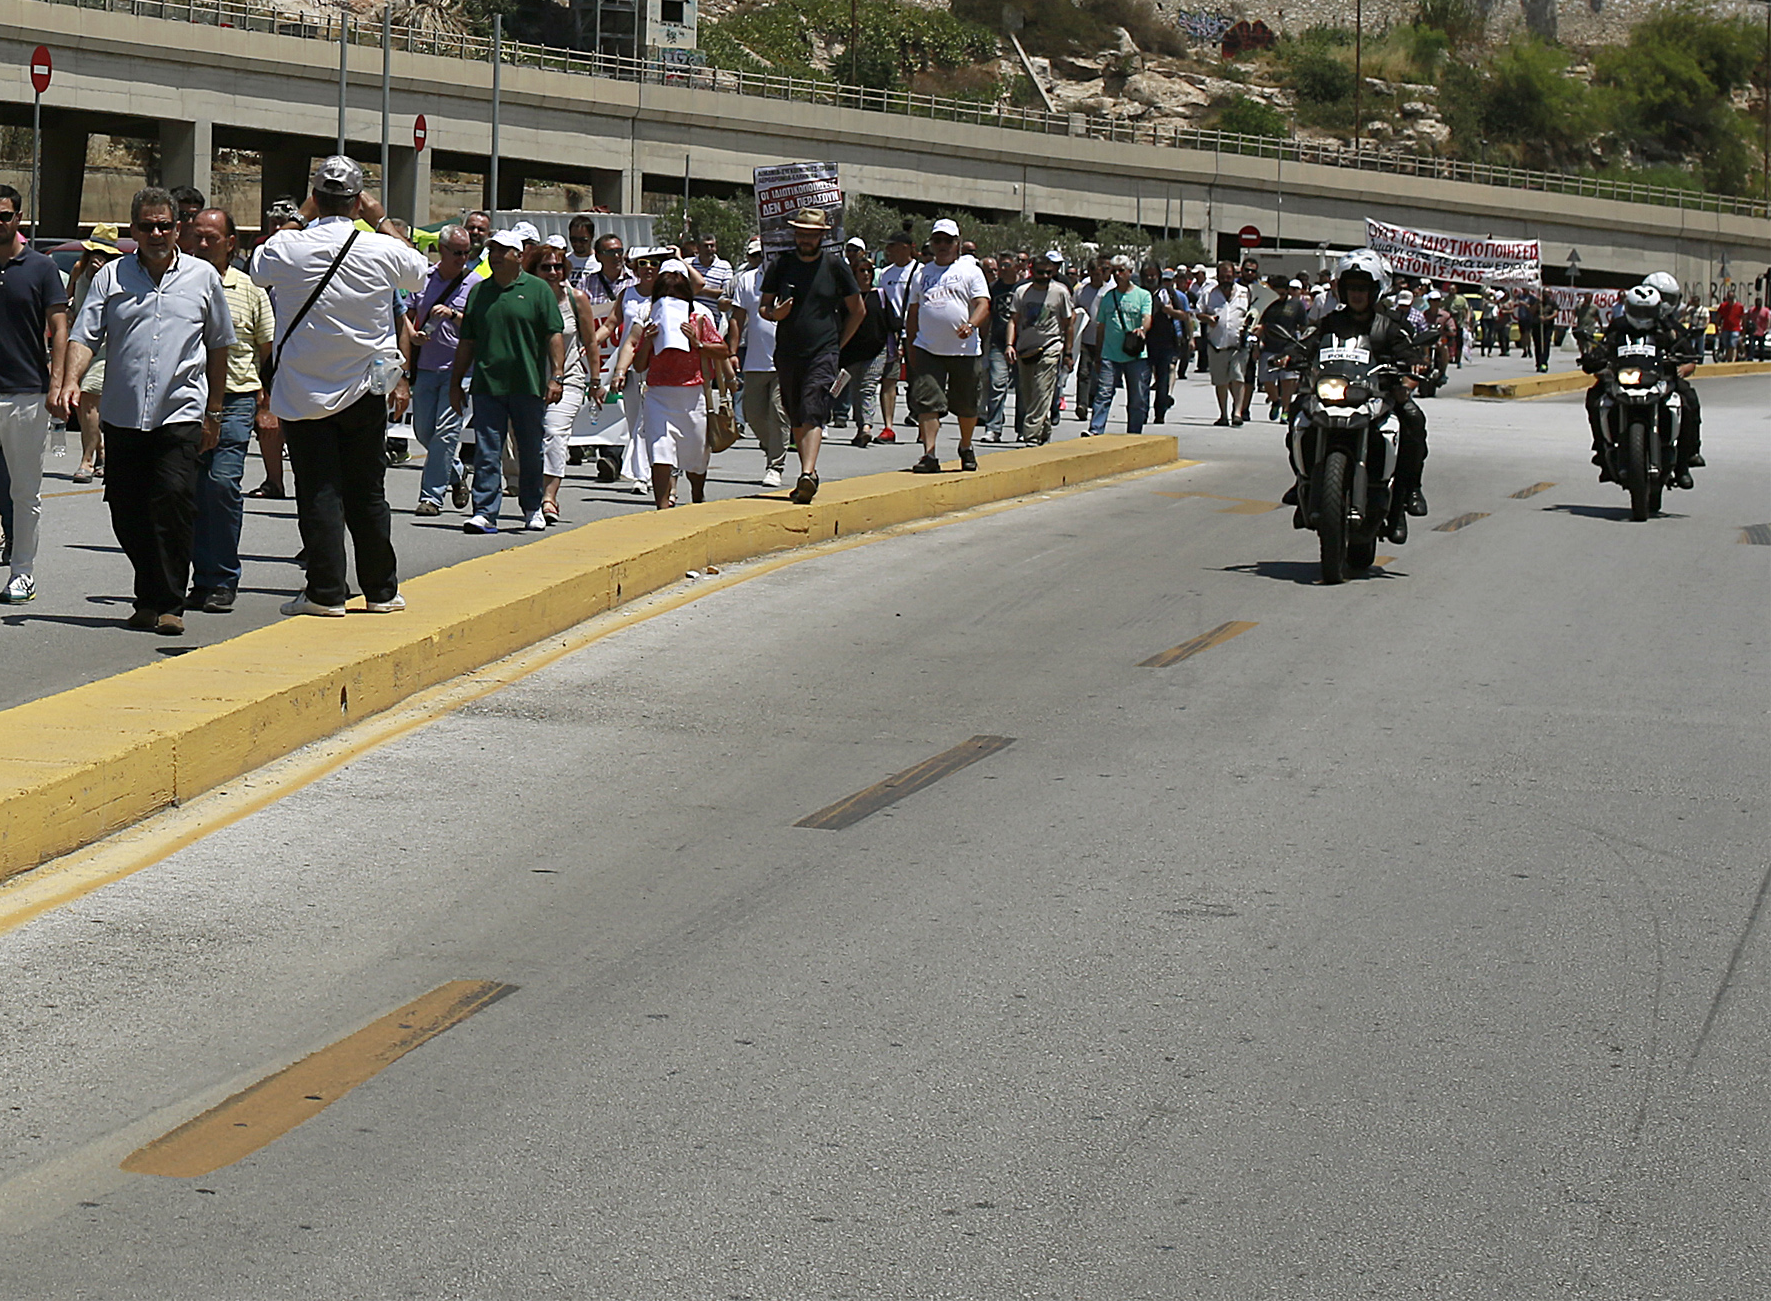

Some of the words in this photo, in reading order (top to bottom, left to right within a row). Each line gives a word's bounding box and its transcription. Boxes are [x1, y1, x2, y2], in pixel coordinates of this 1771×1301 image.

[763, 202, 781, 216] ΔΕΝ
[784, 200, 796, 210] ΘΑ
[796, 190, 839, 208] ΠΕΡΑΣΟΥΝ
